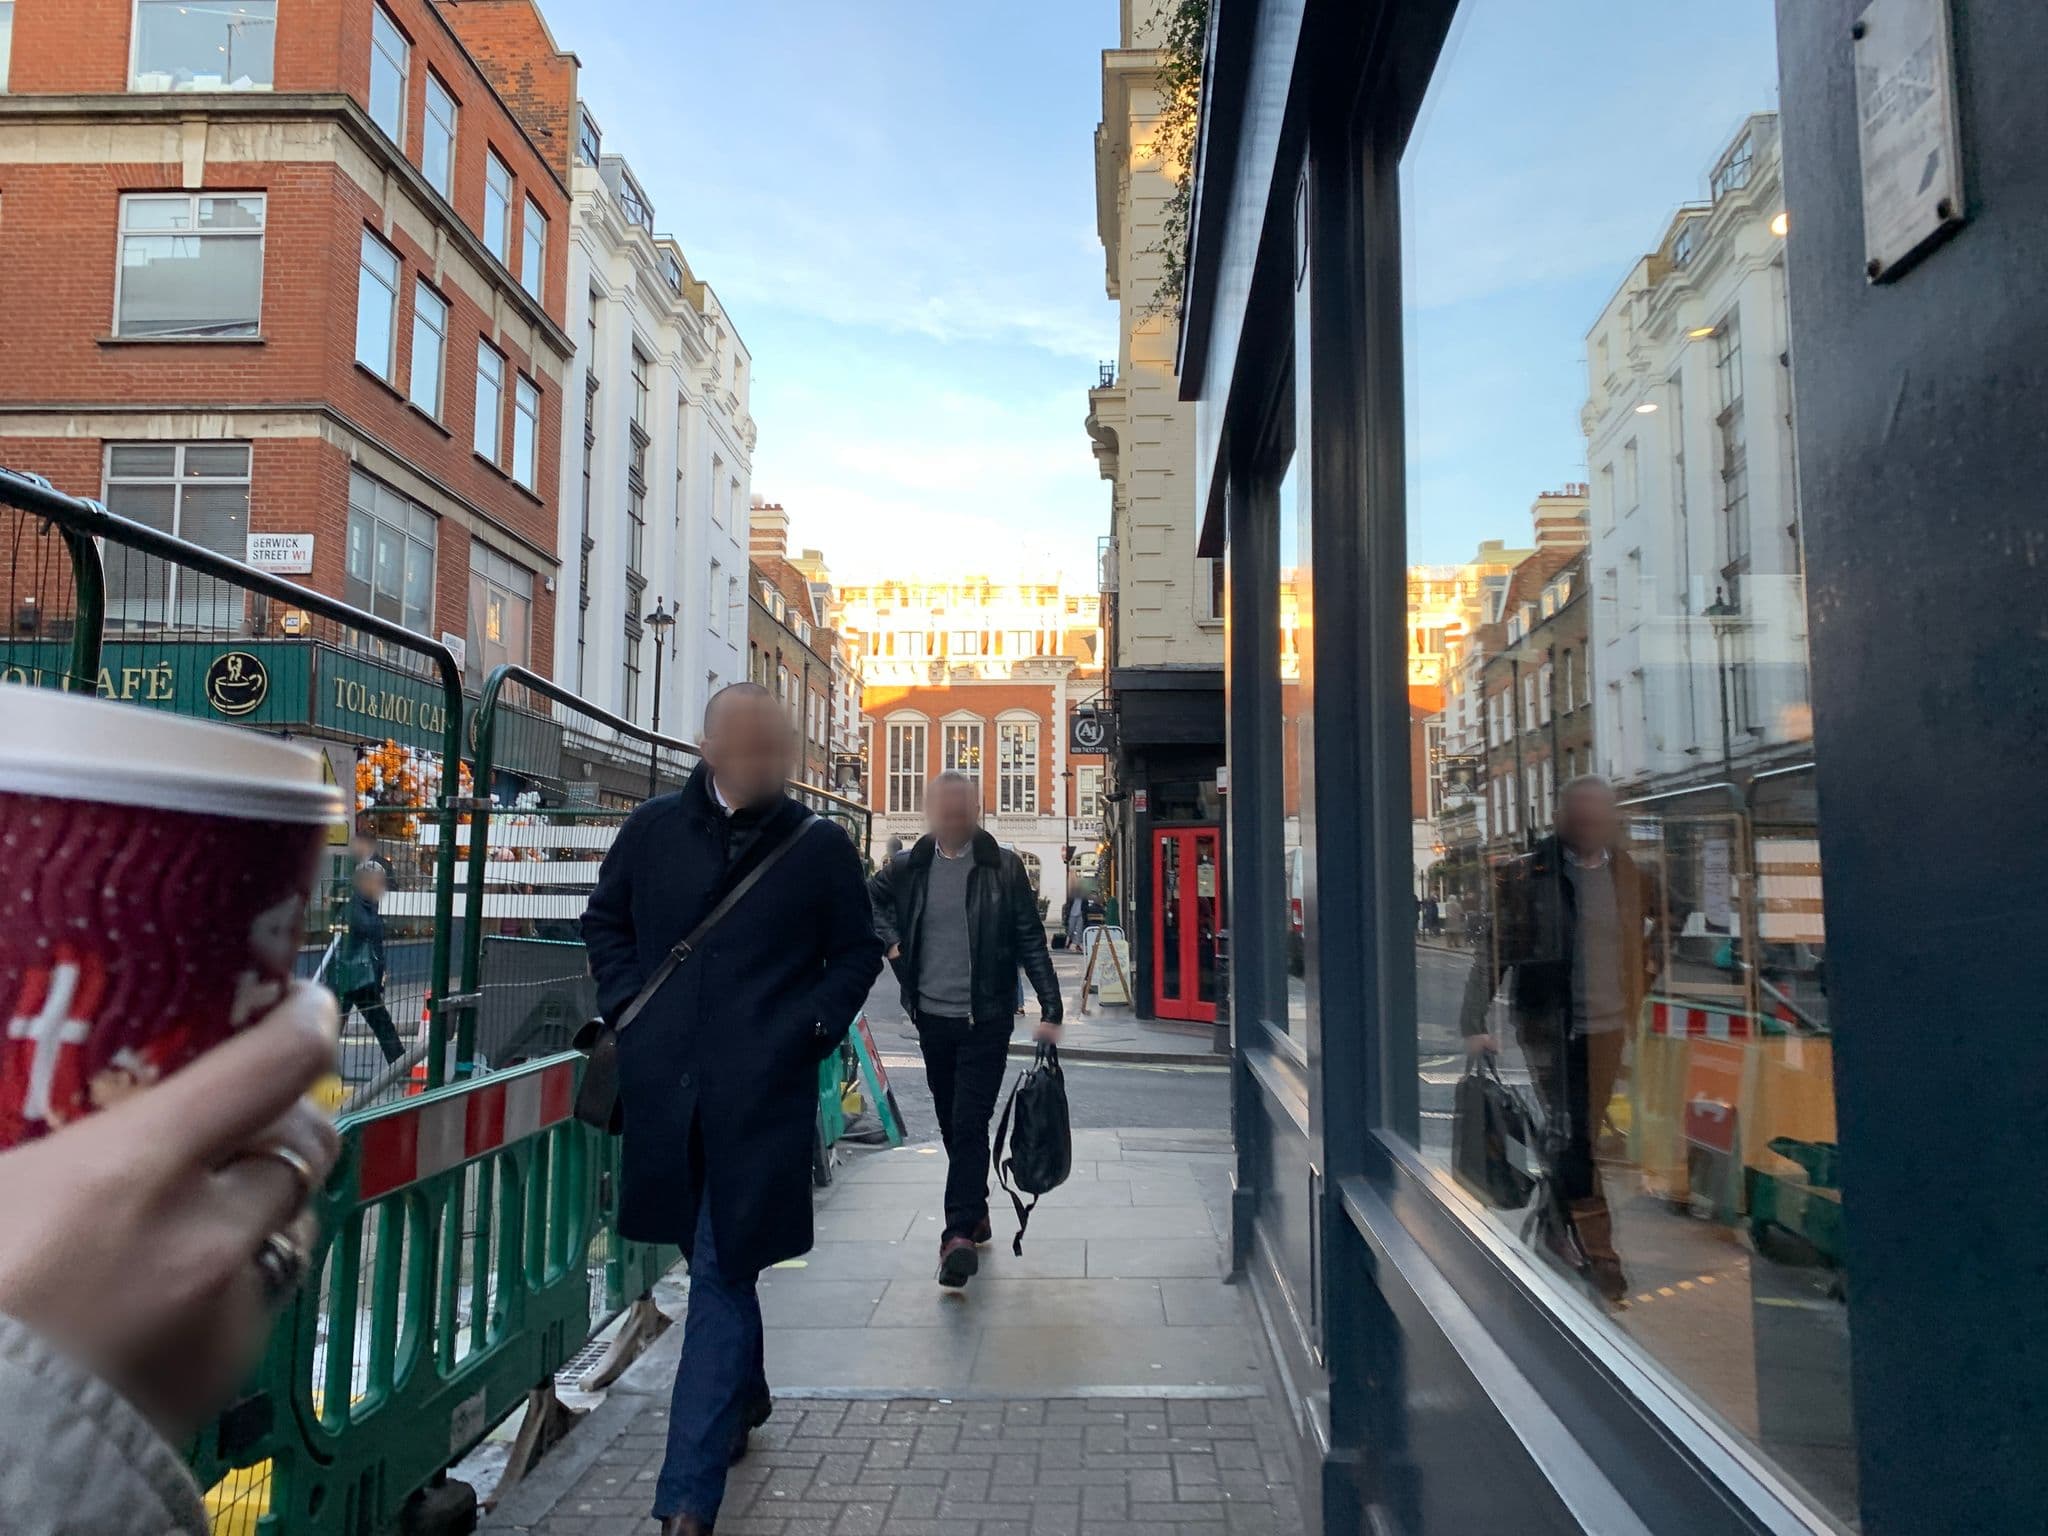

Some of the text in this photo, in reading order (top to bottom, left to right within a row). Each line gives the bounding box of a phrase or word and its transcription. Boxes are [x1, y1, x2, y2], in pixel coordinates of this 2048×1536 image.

[252, 538, 299, 548] BERWICK
[252, 550, 306, 560] STREET W1
[62, 660, 174, 699] AFÉ
